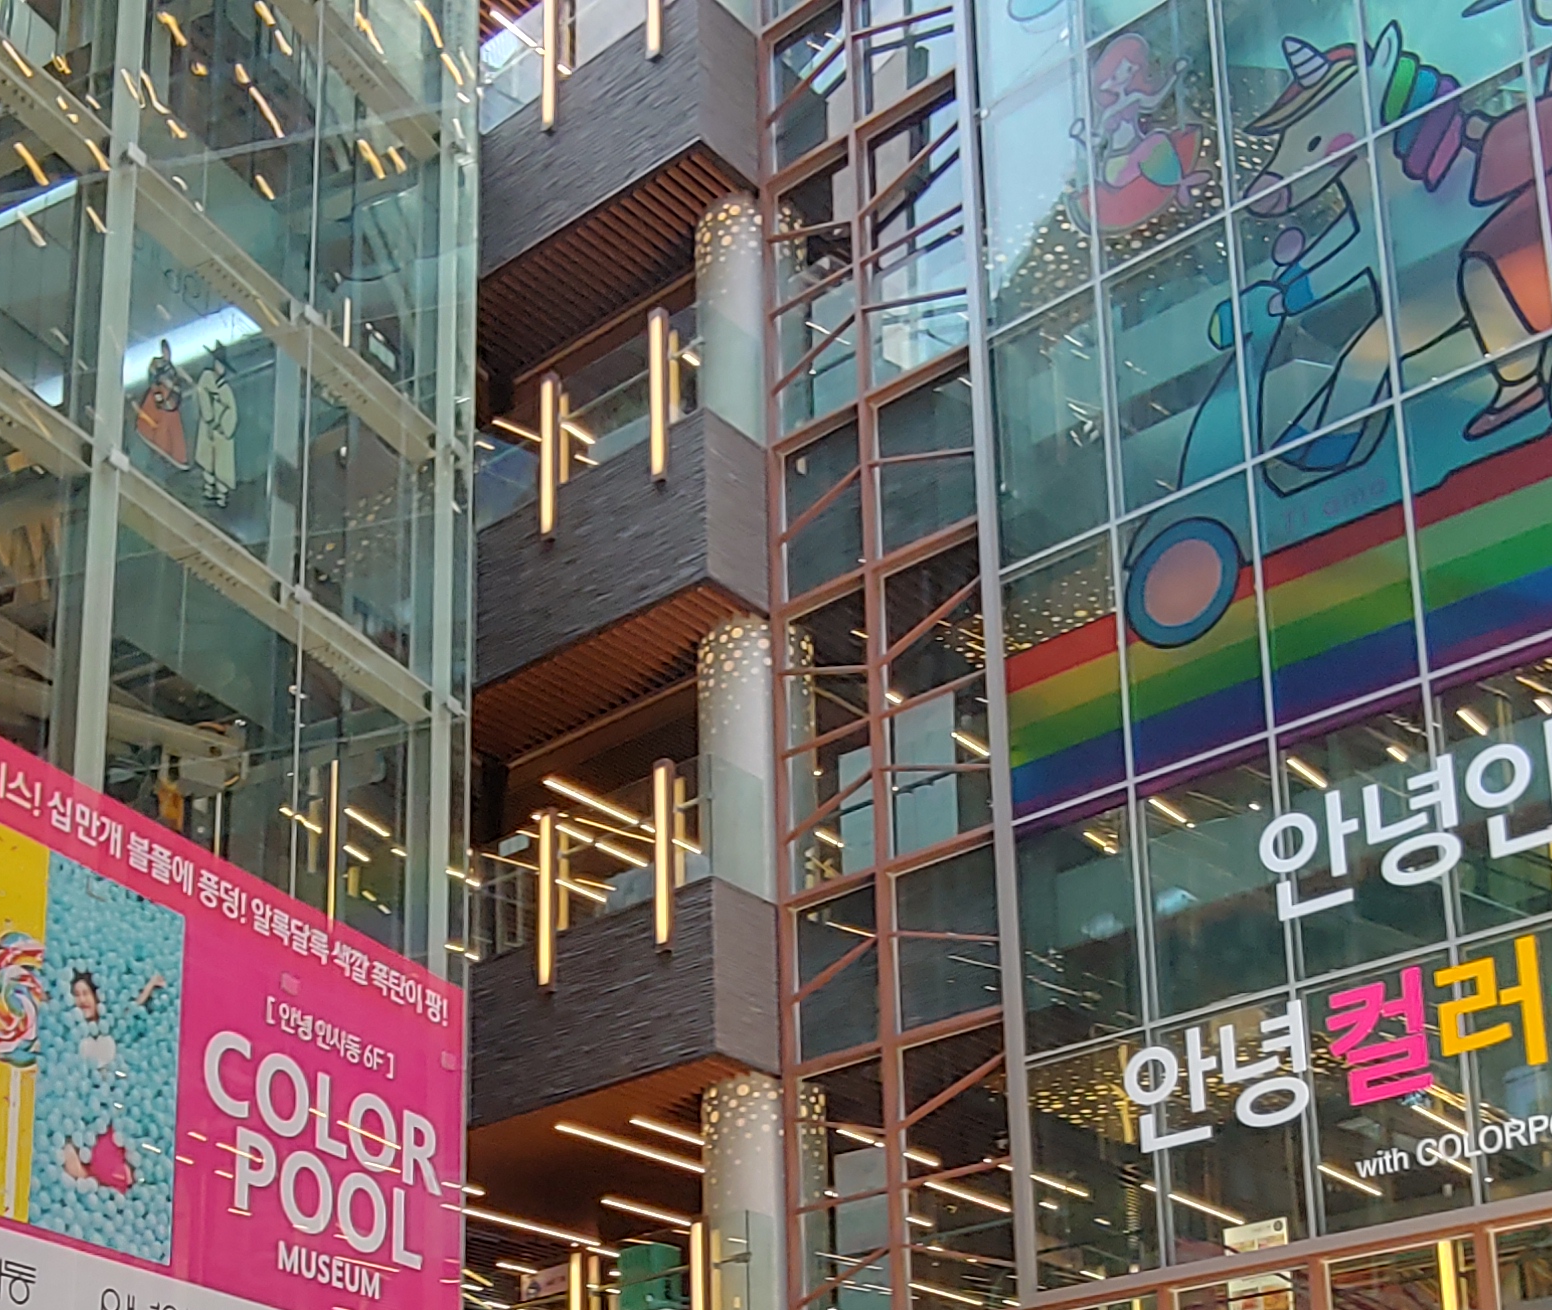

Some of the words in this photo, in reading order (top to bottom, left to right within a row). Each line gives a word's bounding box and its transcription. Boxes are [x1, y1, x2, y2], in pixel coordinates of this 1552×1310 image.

[127, 832, 194, 897] 볼풀에
[198, 869, 248, 924] 풍덩!
[251, 898, 329, 965] 알록달록
[331, 940, 370, 986] 색깔
[371, 960, 423, 1013] 폭탄이
[426, 989, 449, 1026] 팡!
[203, 1030, 442, 1197] COLOR
[363, 1044, 386, 1071] 6F
[1122, 998, 1312, 1154] 안녕
[234, 1126, 423, 1271] POOL
[1355, 1147, 1410, 1180] with
[277, 1240, 382, 1300] MUSEUM
